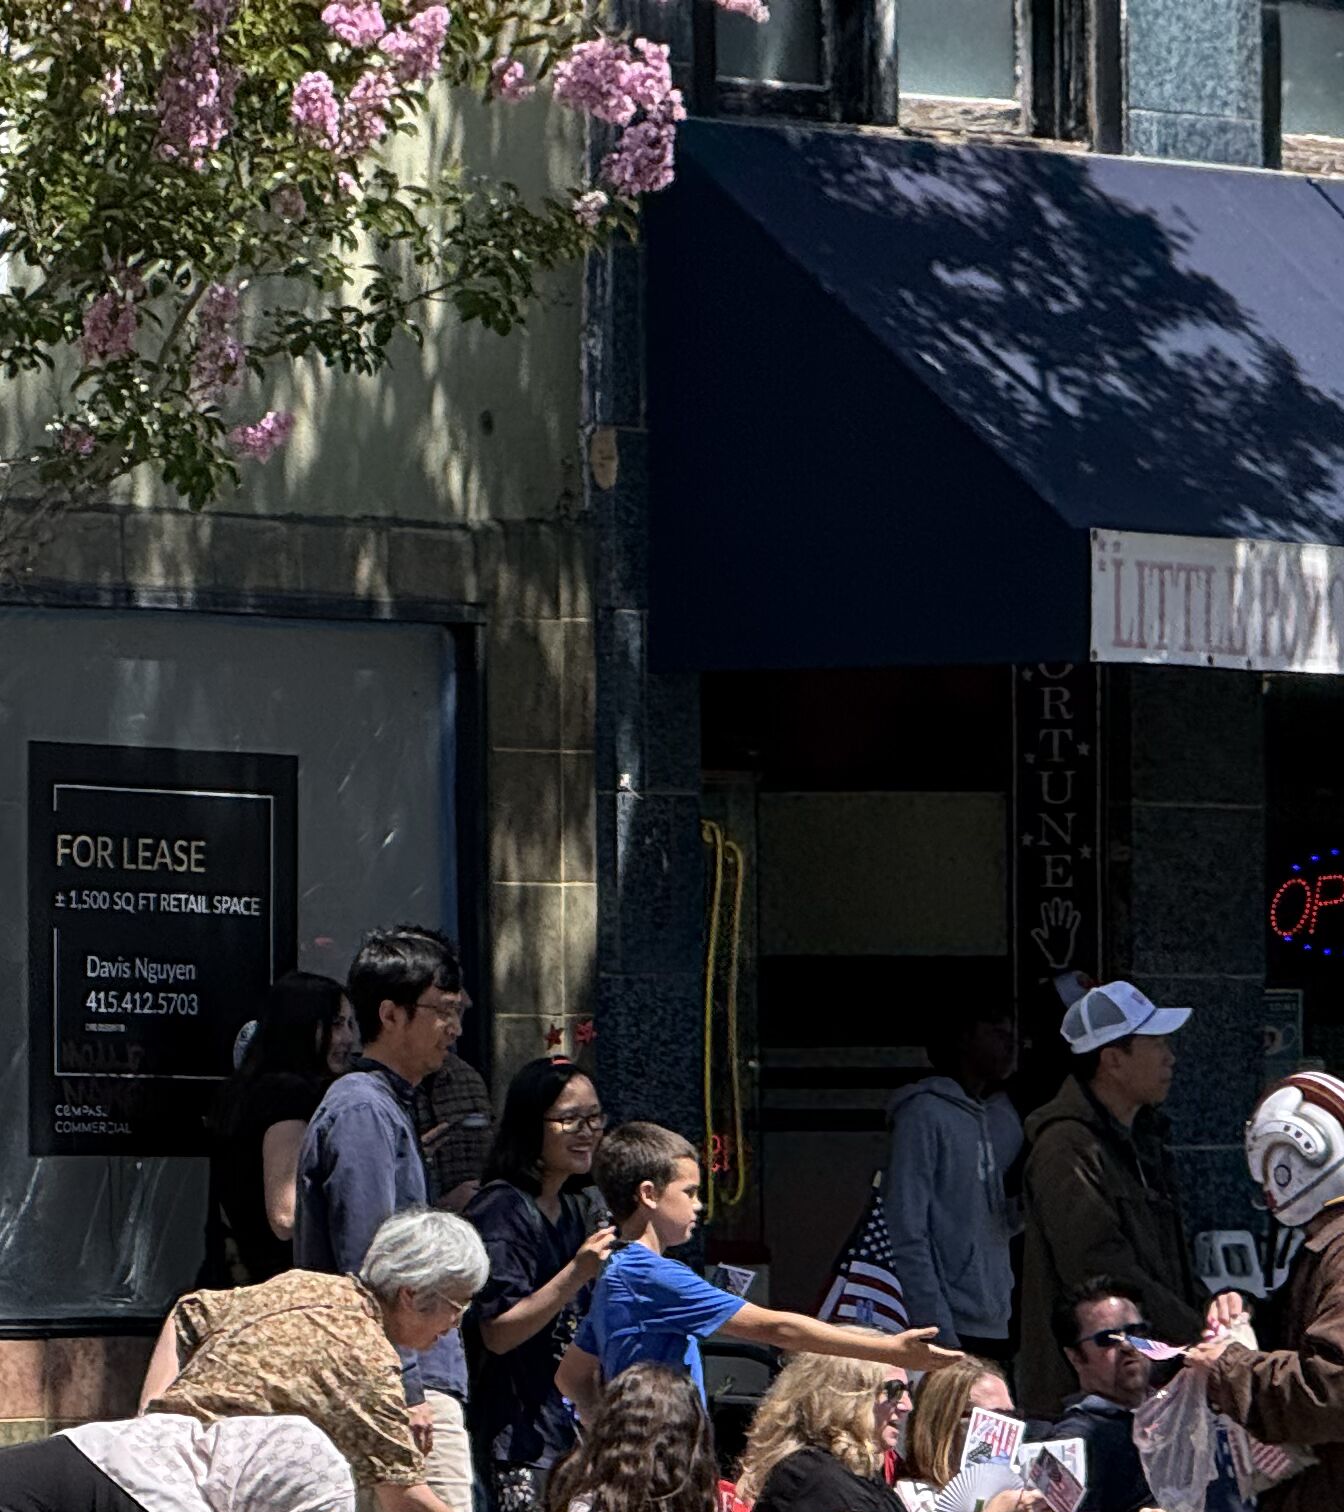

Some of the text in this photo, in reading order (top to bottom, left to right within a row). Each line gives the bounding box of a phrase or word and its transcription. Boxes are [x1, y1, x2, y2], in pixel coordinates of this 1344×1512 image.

[56, 834, 206, 873] FOR LEASE
[69, 890, 109, 911] 1,500
[113, 892, 136, 913] SQ
[138, 893, 157, 911] FT
[159, 893, 211, 914] RETAIL
[213, 895, 261, 916] SPACE
[86, 955, 196, 983] Davis Nguyen
[86, 990, 199, 1015] 415.412.5703
